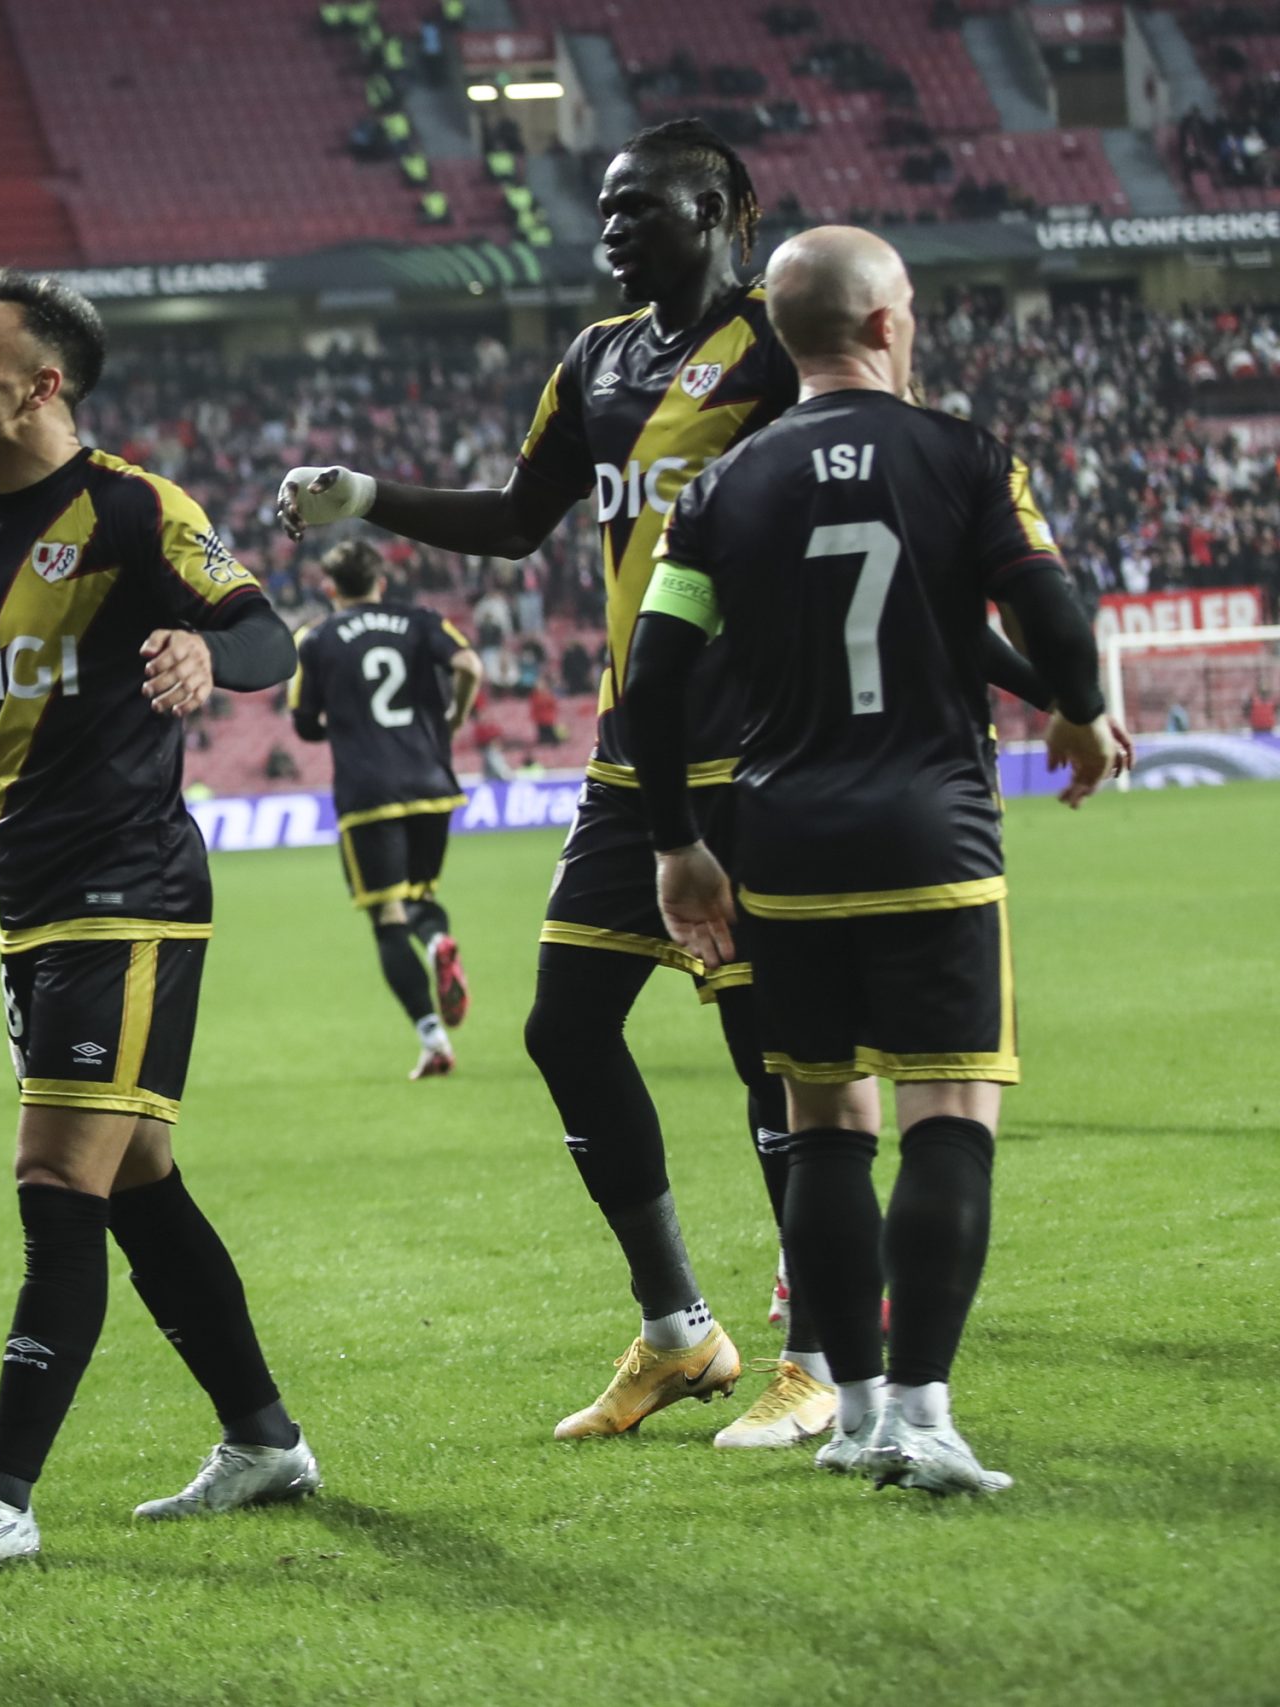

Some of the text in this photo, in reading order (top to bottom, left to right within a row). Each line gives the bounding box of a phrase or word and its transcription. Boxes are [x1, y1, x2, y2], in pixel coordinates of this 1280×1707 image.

[1036, 221, 1109, 249] UEFA
[158, 261, 266, 295] LEAGUE
[812, 444, 875, 483] ISI
[662, 576, 713, 603] RESPEC
[804, 520, 901, 715] 7
[361, 646, 414, 728] 2
[503, 779, 579, 826] Bra
